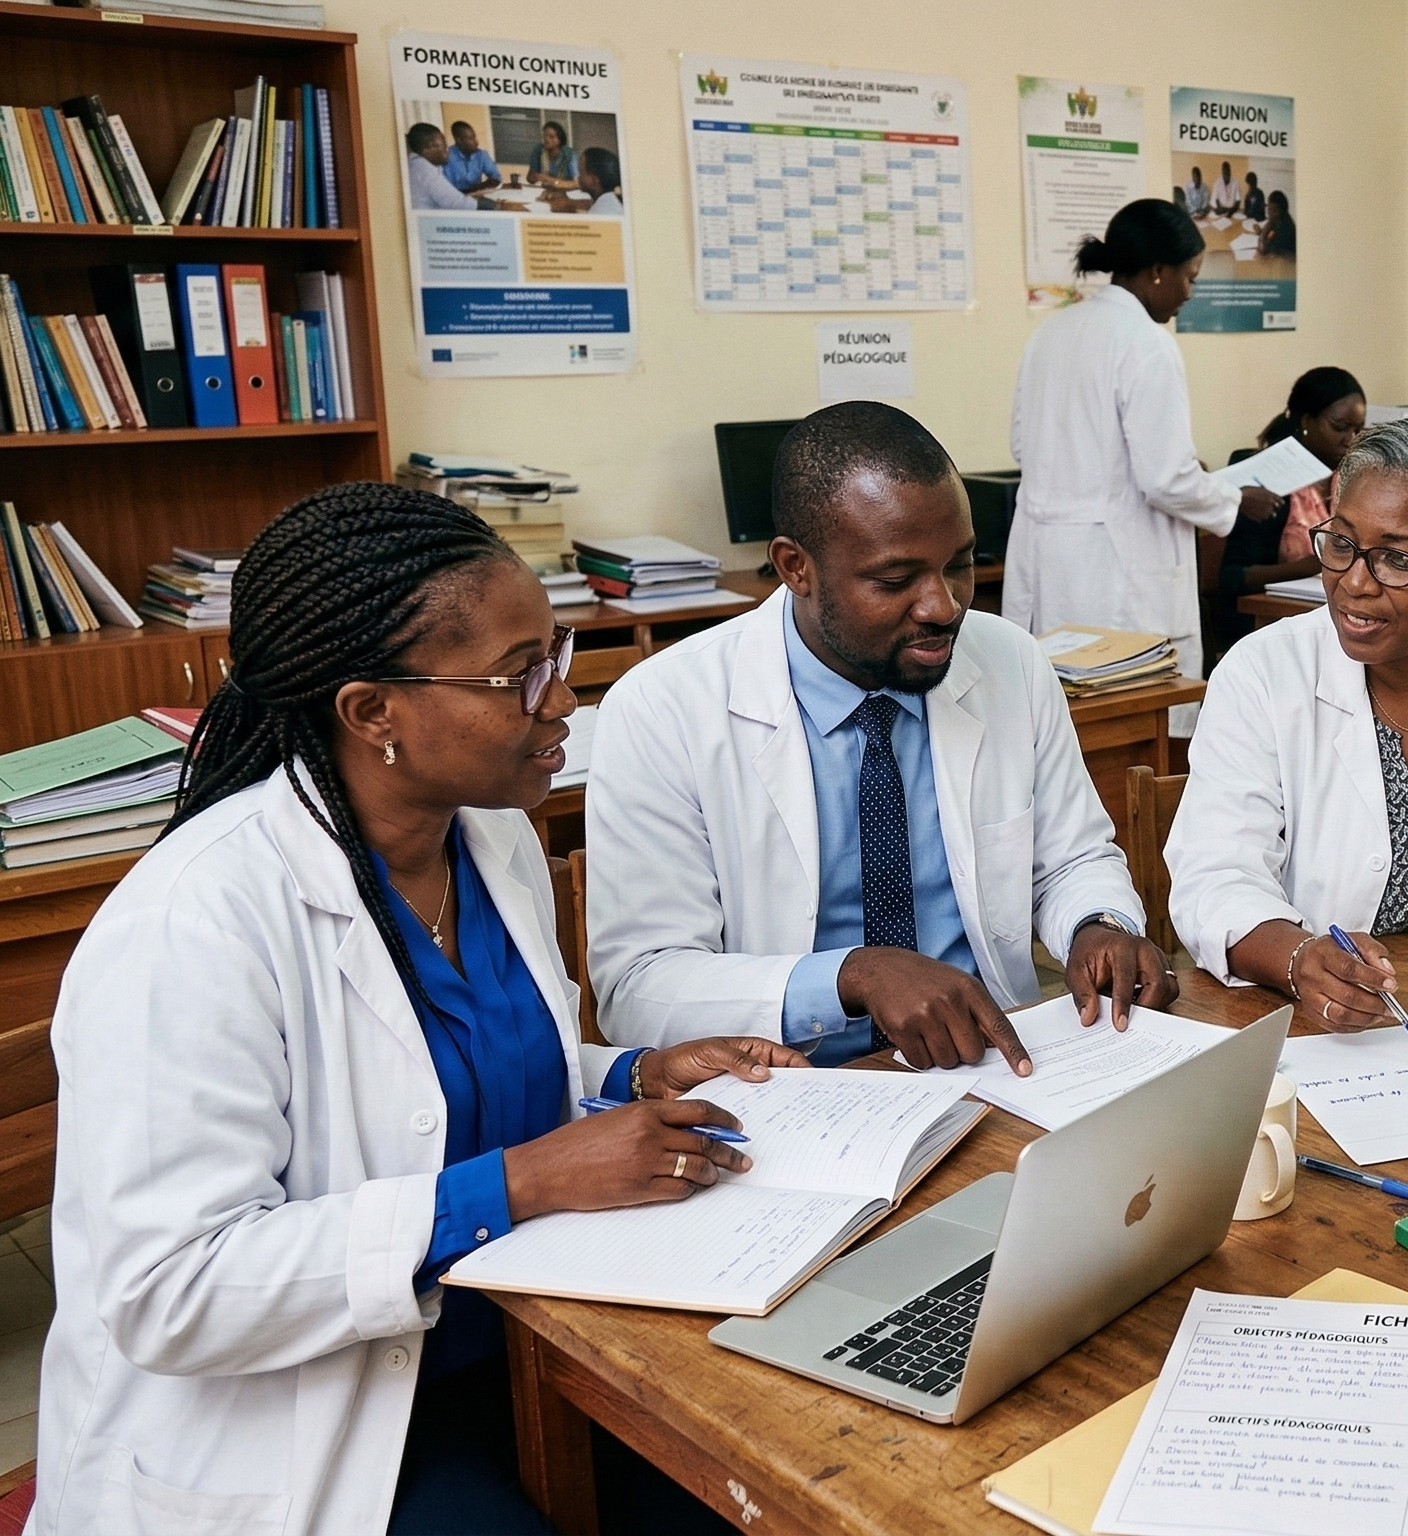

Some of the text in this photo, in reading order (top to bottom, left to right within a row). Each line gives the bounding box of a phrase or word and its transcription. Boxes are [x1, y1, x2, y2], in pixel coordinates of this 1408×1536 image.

[403, 47, 608, 78] FORMATION CONTINUE
[426, 73, 590, 99] DES ENSEIGNANTS
[1199, 102, 1268, 123] REUNION
[1179, 122, 1288, 148] PÉDAGOGIQUE
[838, 331, 891, 344] RÉUNION
[823, 350, 907, 364] PÉDAGOGIQUE
